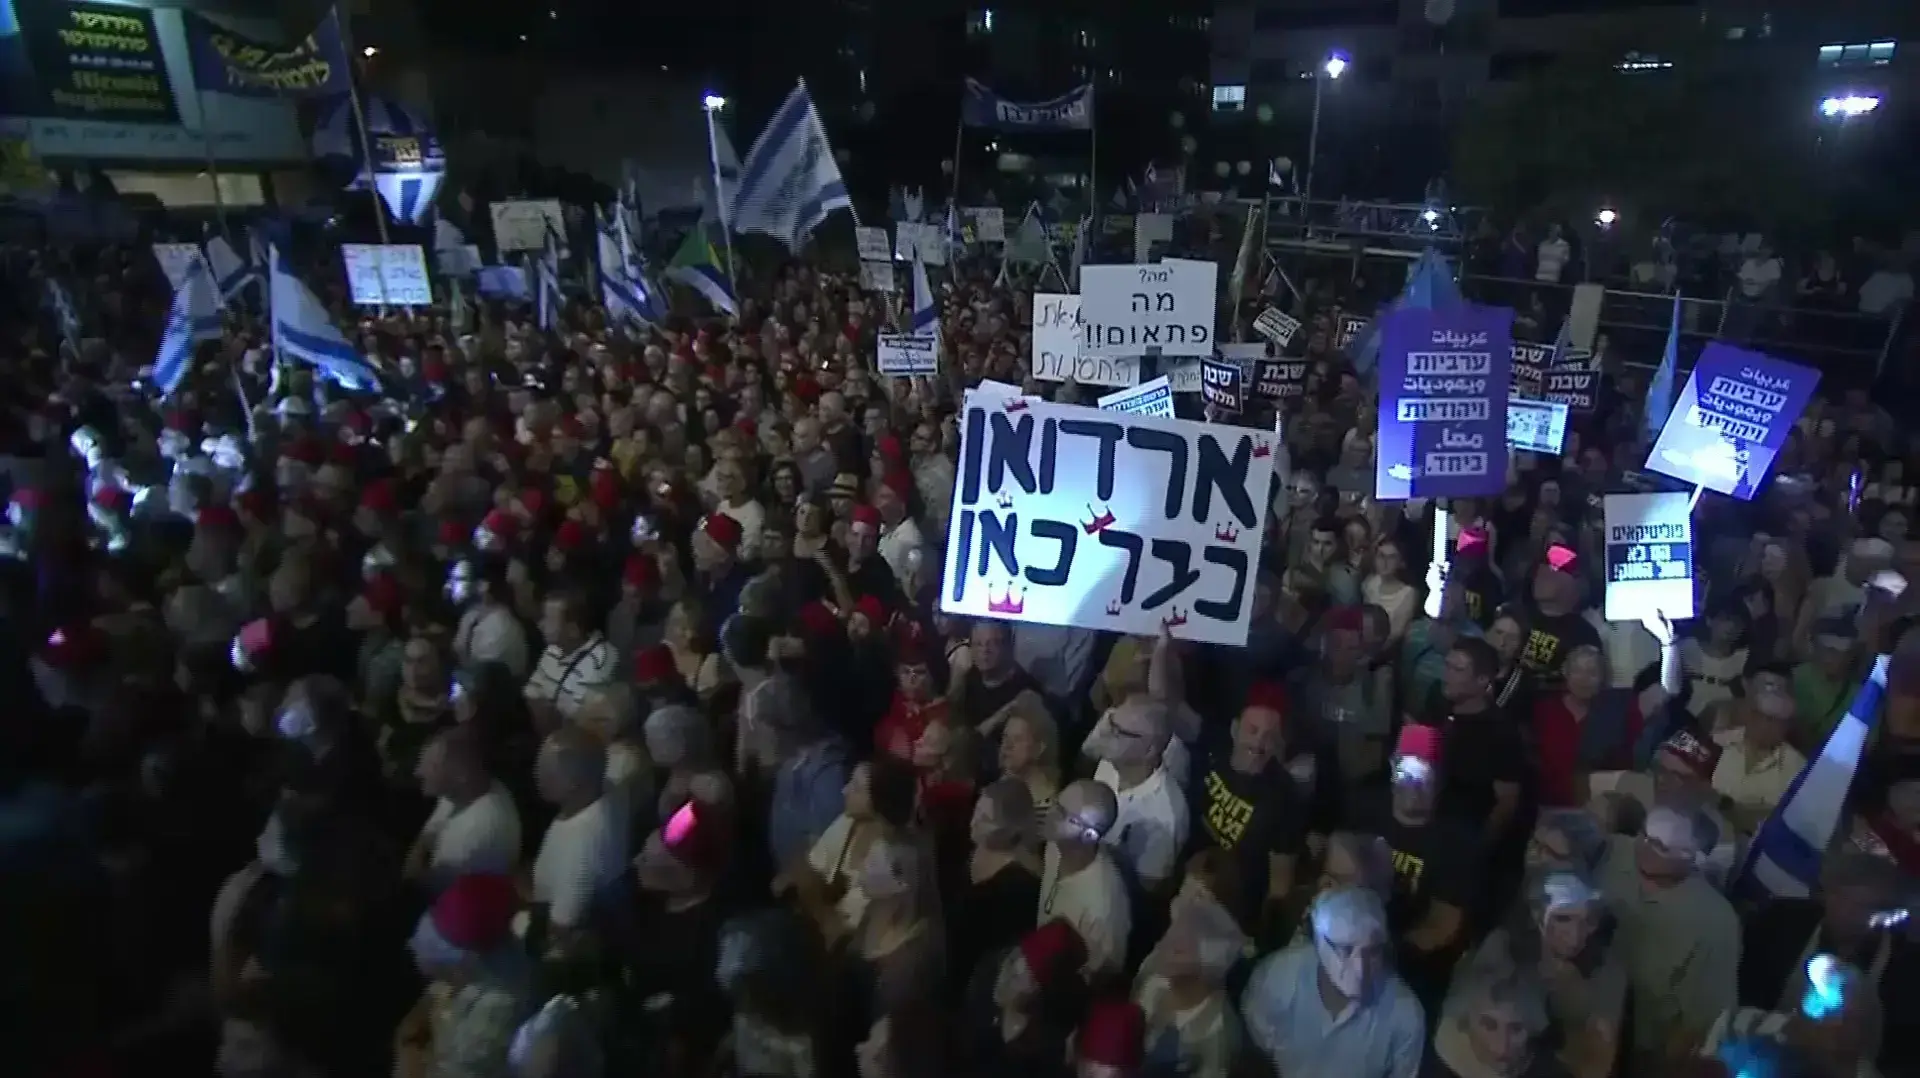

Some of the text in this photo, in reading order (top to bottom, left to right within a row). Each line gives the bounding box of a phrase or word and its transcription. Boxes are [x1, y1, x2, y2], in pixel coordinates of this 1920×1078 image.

[1132, 292, 1175, 312] מה
[1086, 324, 1208, 349] פתאום!!
[1263, 364, 1306, 380] שבת
[1413, 354, 1487, 372] ערביות
[1203, 364, 1232, 386] שבת
[1550, 375, 1591, 390] שבת
[1715, 379, 1782, 407] ערביות
[1403, 402, 1486, 419] ויהודיות
[961, 407, 1258, 529] ארדואן
[1427, 455, 1485, 473] ביחד.
[1611, 523, 1684, 541] פוליטיקאים
[952, 508, 1248, 621] כבר כאן
